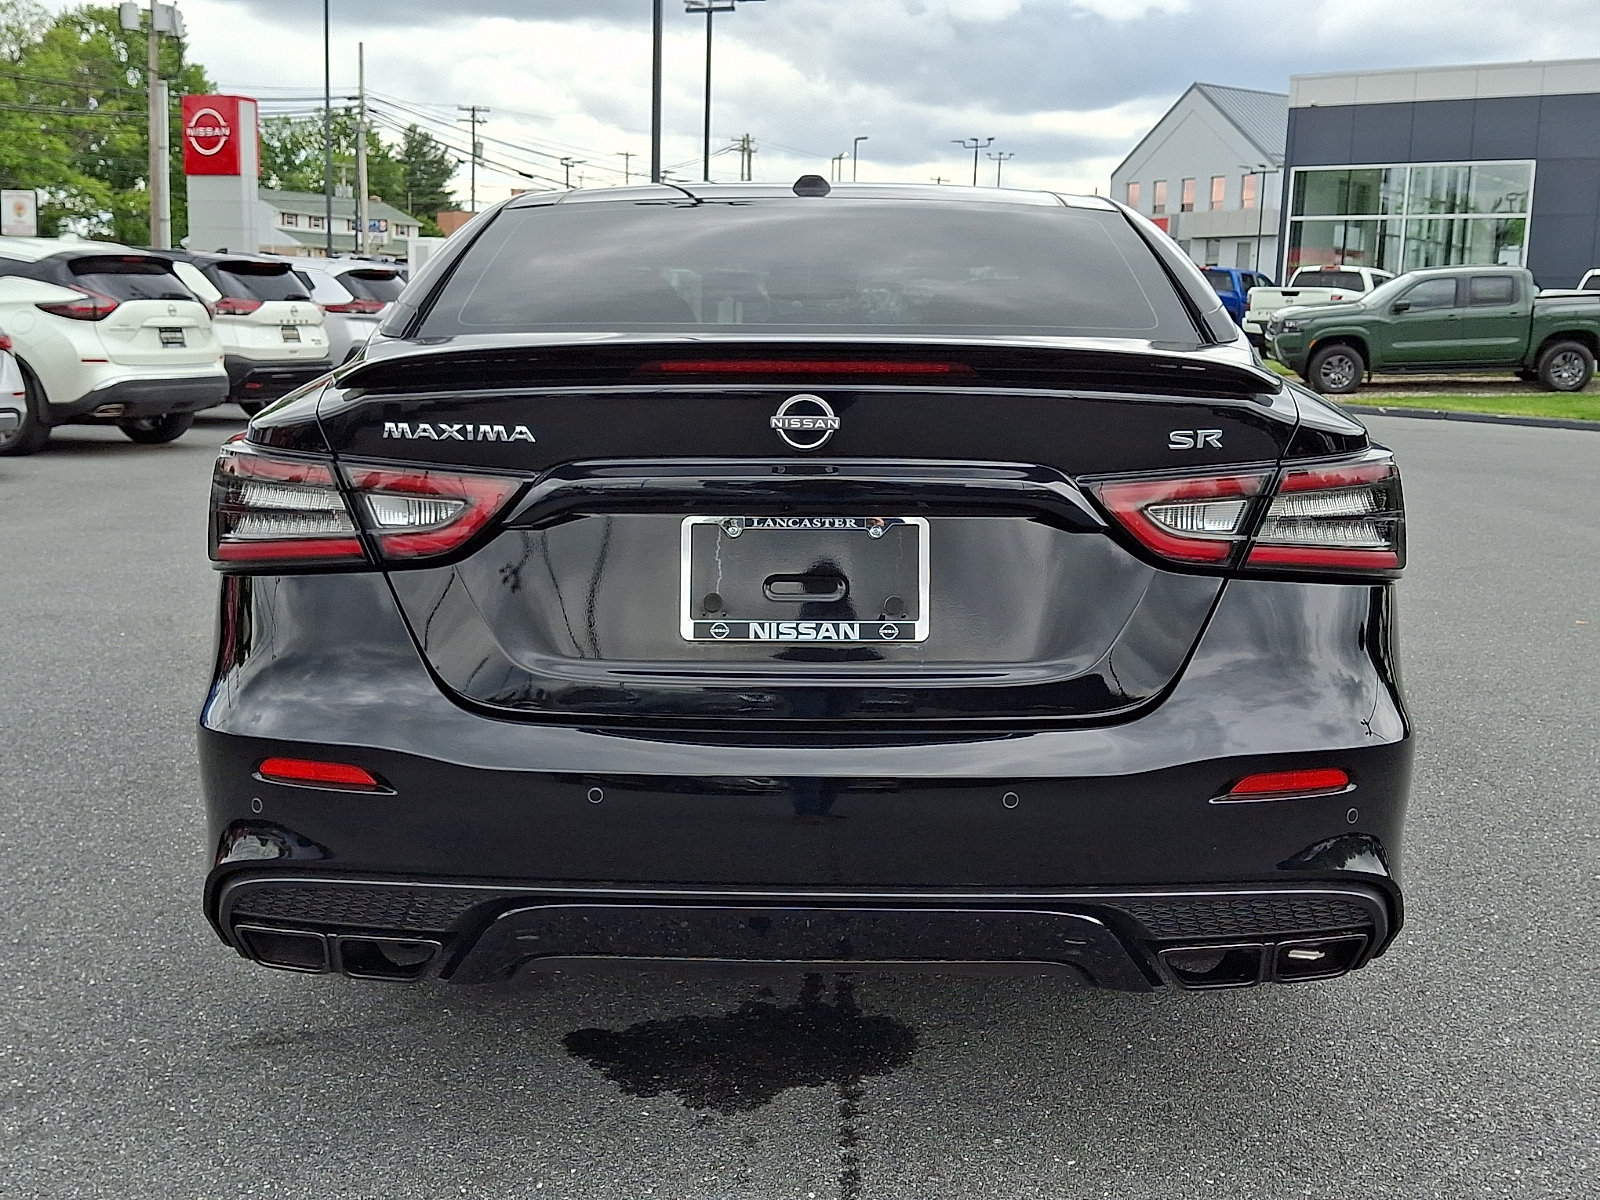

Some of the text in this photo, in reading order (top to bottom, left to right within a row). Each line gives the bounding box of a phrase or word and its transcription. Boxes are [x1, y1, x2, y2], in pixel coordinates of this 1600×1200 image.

[186, 126, 230, 137] NISSAN
[771, 418, 839, 429] NISSAN
[382, 421, 536, 443] MAXIMA
[1168, 429, 1223, 450] SR
[752, 518, 858, 528] LANCASTER
[749, 622, 860, 640] NISSAN
